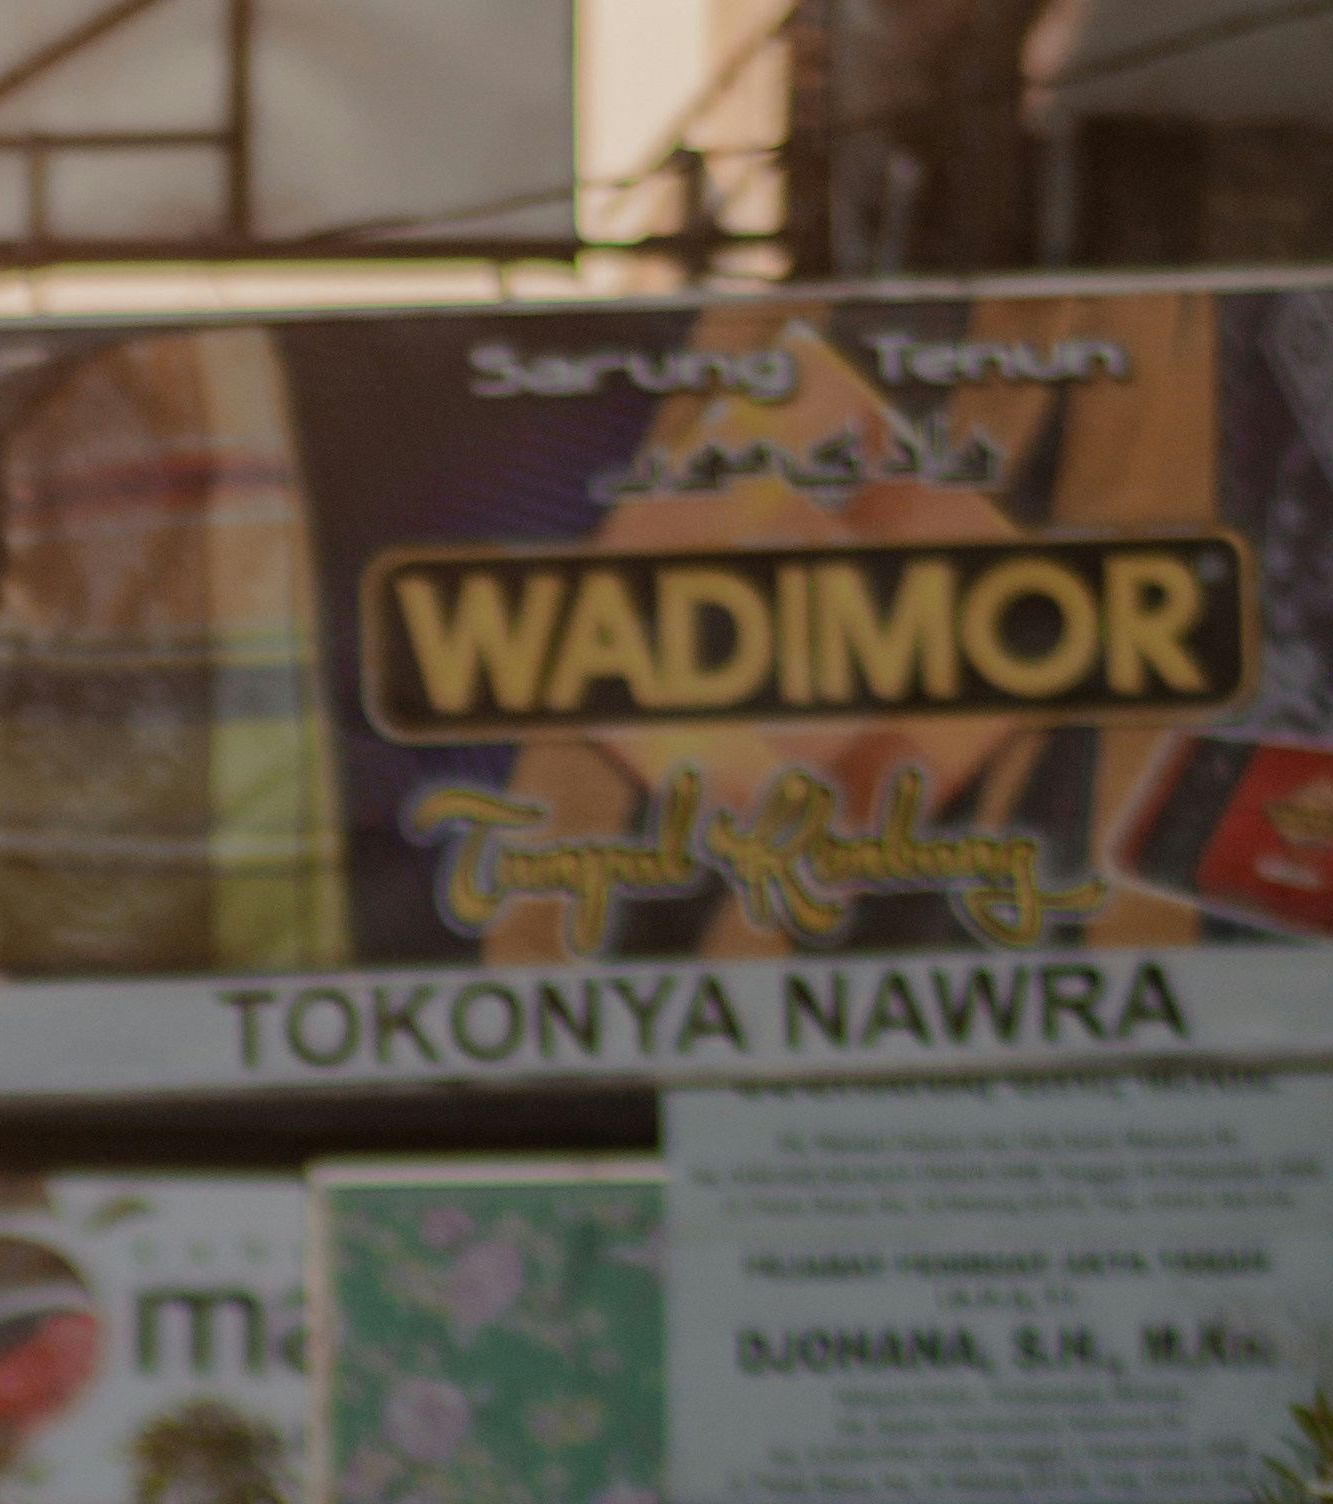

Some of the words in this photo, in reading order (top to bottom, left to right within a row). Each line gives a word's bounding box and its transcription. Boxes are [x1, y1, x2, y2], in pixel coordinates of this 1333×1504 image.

[467, 341, 796, 402] Sarung
[864, 331, 1130, 384] Tenun
[393, 555, 1211, 712] WADIMOR
[223, 968, 744, 1074] TOKONYA
[785, 960, 1191, 1052] NAWRA
